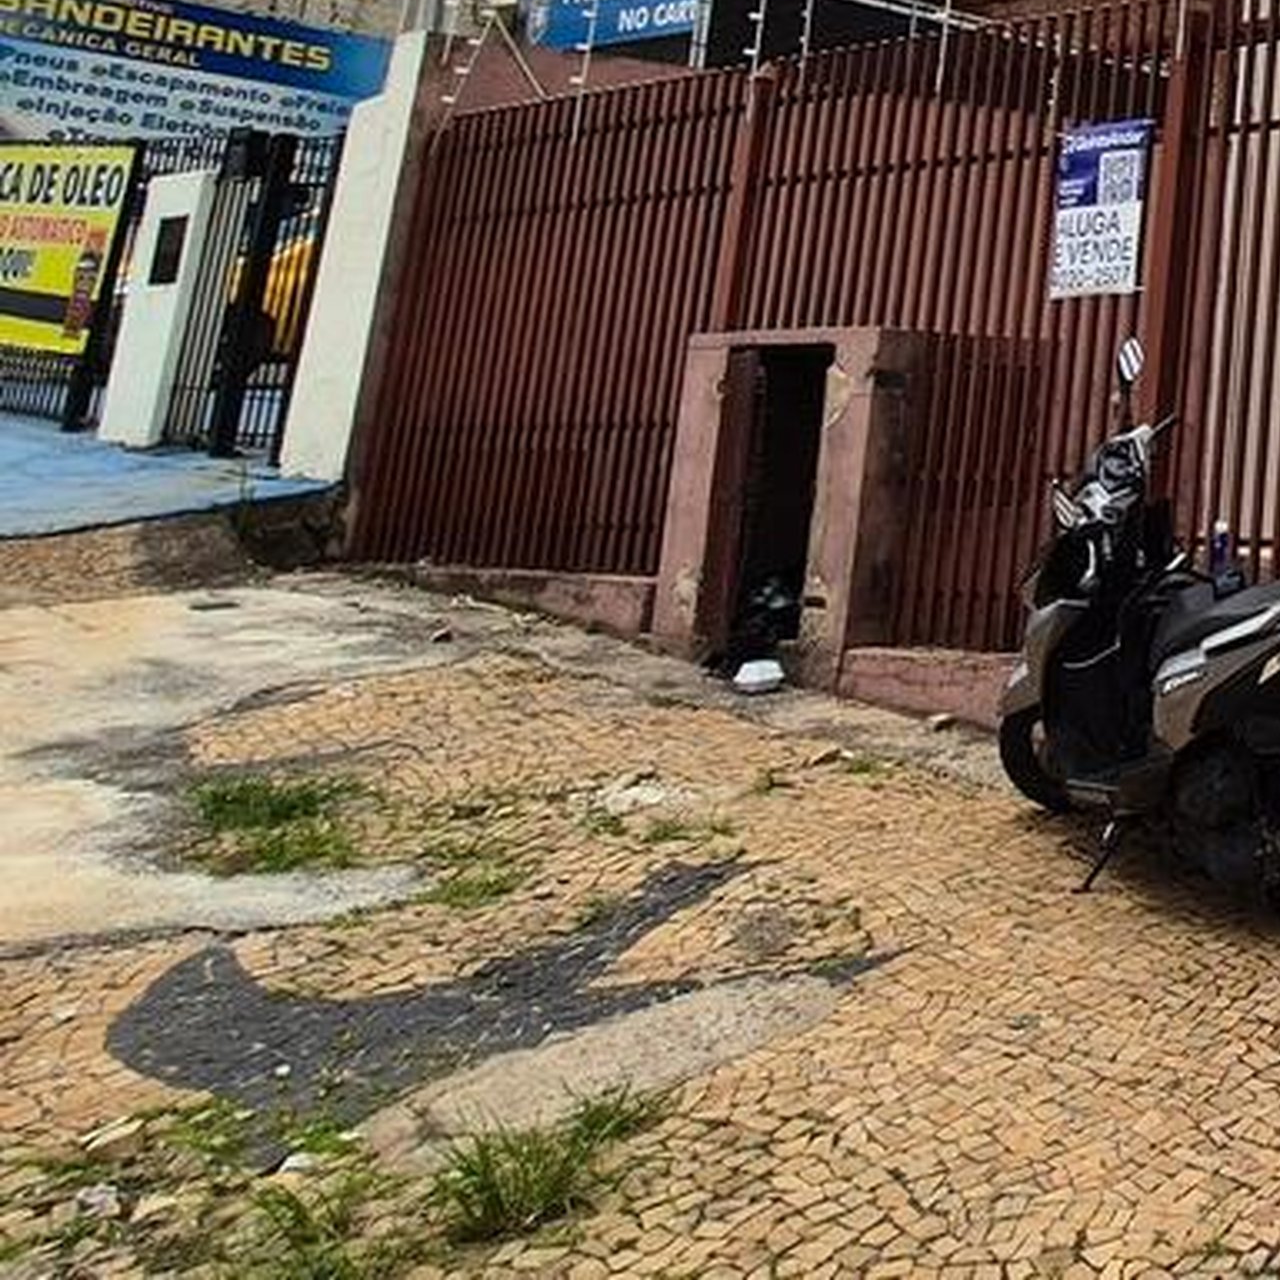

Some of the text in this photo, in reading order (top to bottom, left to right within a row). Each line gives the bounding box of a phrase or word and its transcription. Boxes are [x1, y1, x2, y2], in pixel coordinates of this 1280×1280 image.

[618, 0, 698, 32] NO CART
[125, 40, 201, 67] GERAL
[109, 63, 271, 104] Escapamento
[12, 69, 320, 131] Embreagem Suspensão
[35, 96, 132, 125] Injeção
[27, 164, 60, 204] DE
[1068, 236, 1134, 265] VENDE
